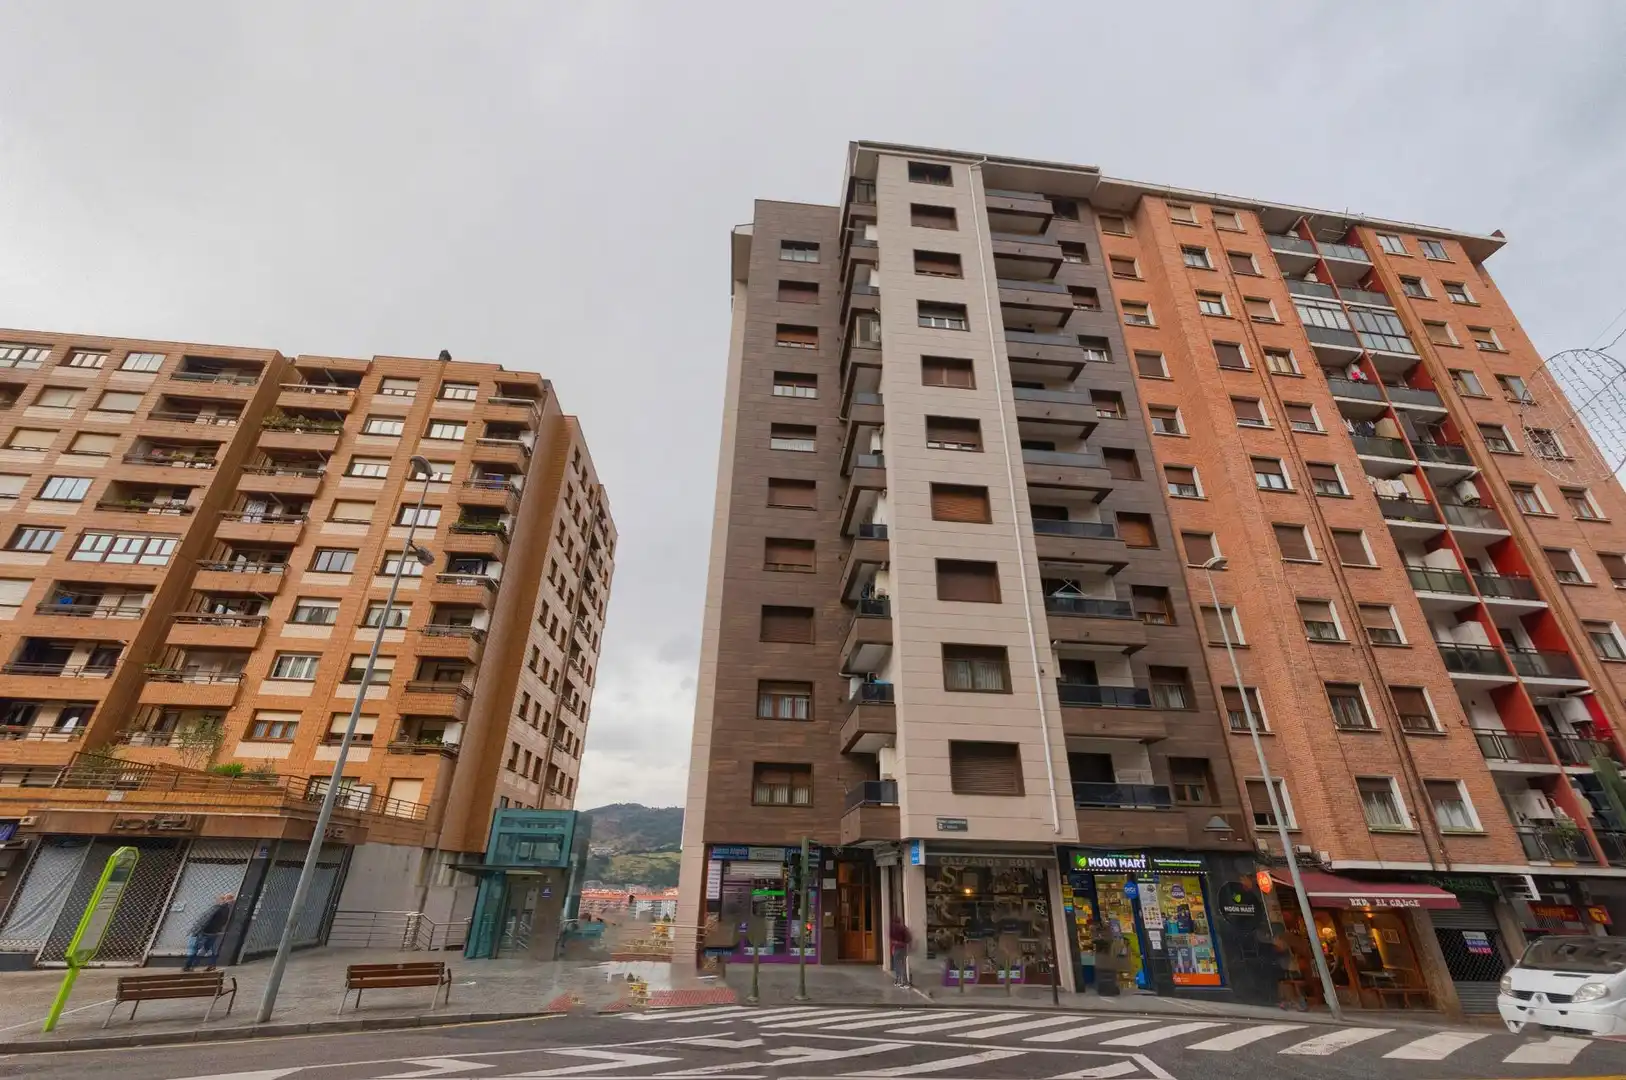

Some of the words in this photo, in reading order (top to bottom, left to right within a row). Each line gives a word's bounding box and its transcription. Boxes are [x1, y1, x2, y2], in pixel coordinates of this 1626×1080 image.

[939, 856, 1001, 867] CALZADOS
[1088, 857, 1117, 868] MOON
[1119, 857, 1146, 868] MART
[1349, 897, 1369, 907] BAR
[1375, 898, 1388, 907] EL
[1240, 905, 1255, 913] MART
